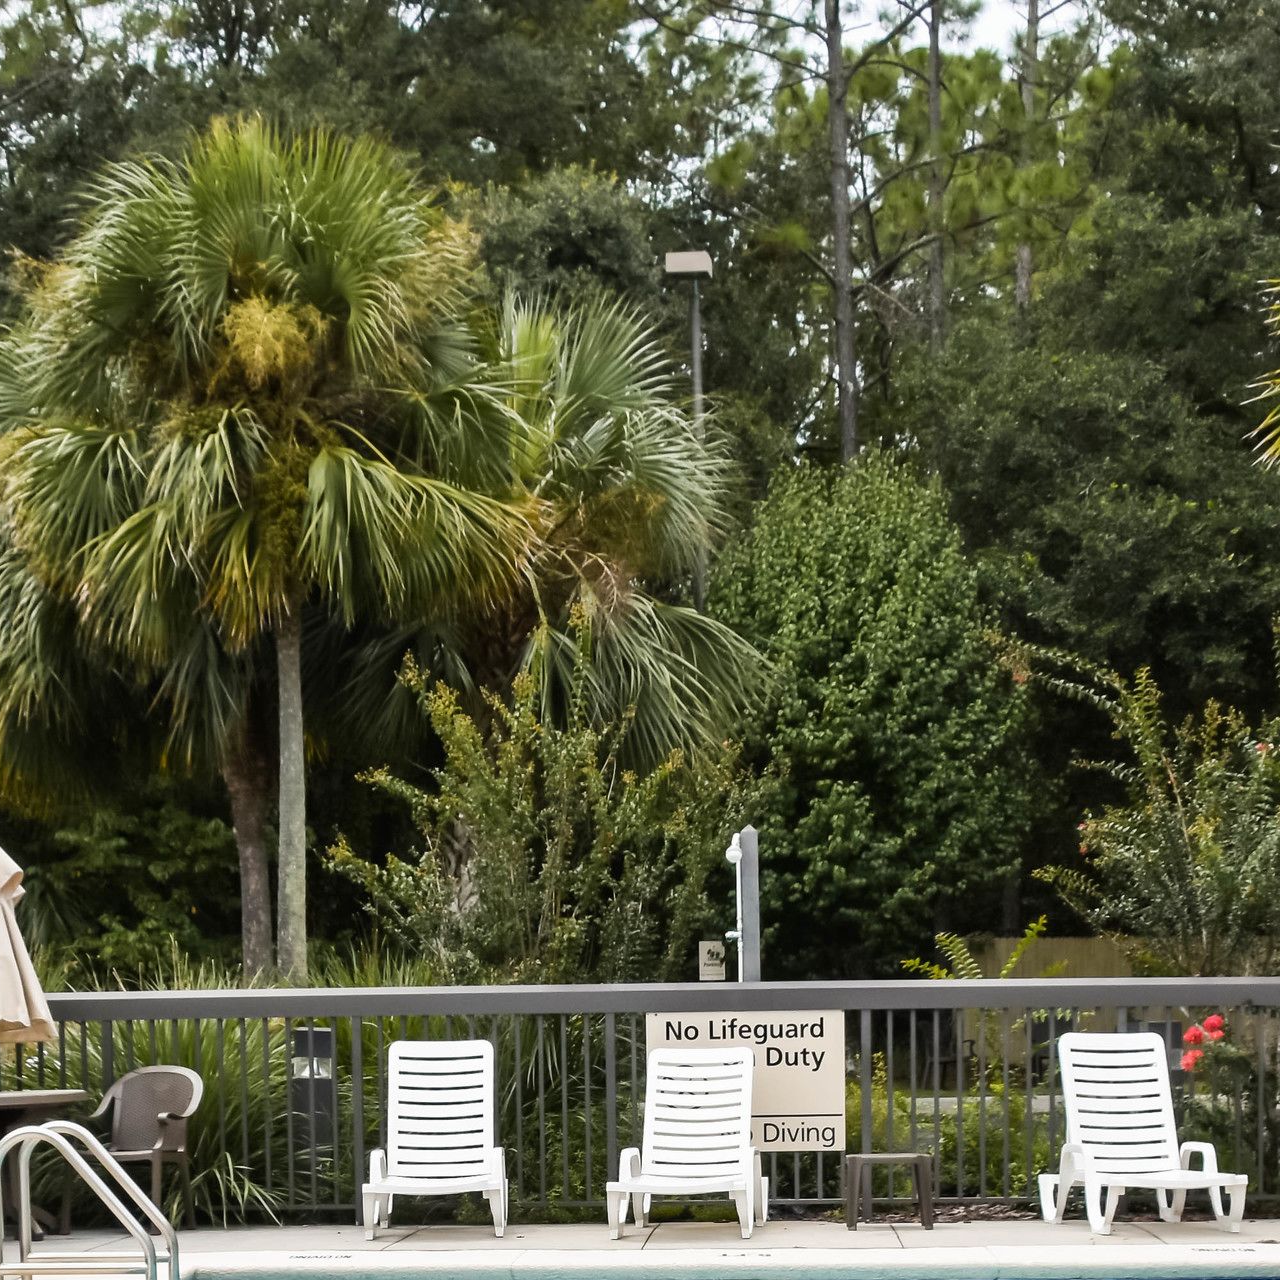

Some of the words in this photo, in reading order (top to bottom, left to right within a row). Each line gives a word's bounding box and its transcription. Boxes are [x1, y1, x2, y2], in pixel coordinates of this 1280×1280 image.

[665, 1021, 699, 1041] No
[709, 1017, 825, 1044] Lifeguard
[766, 1047, 825, 1071] Duty
[763, 1122, 836, 1147] Diving
